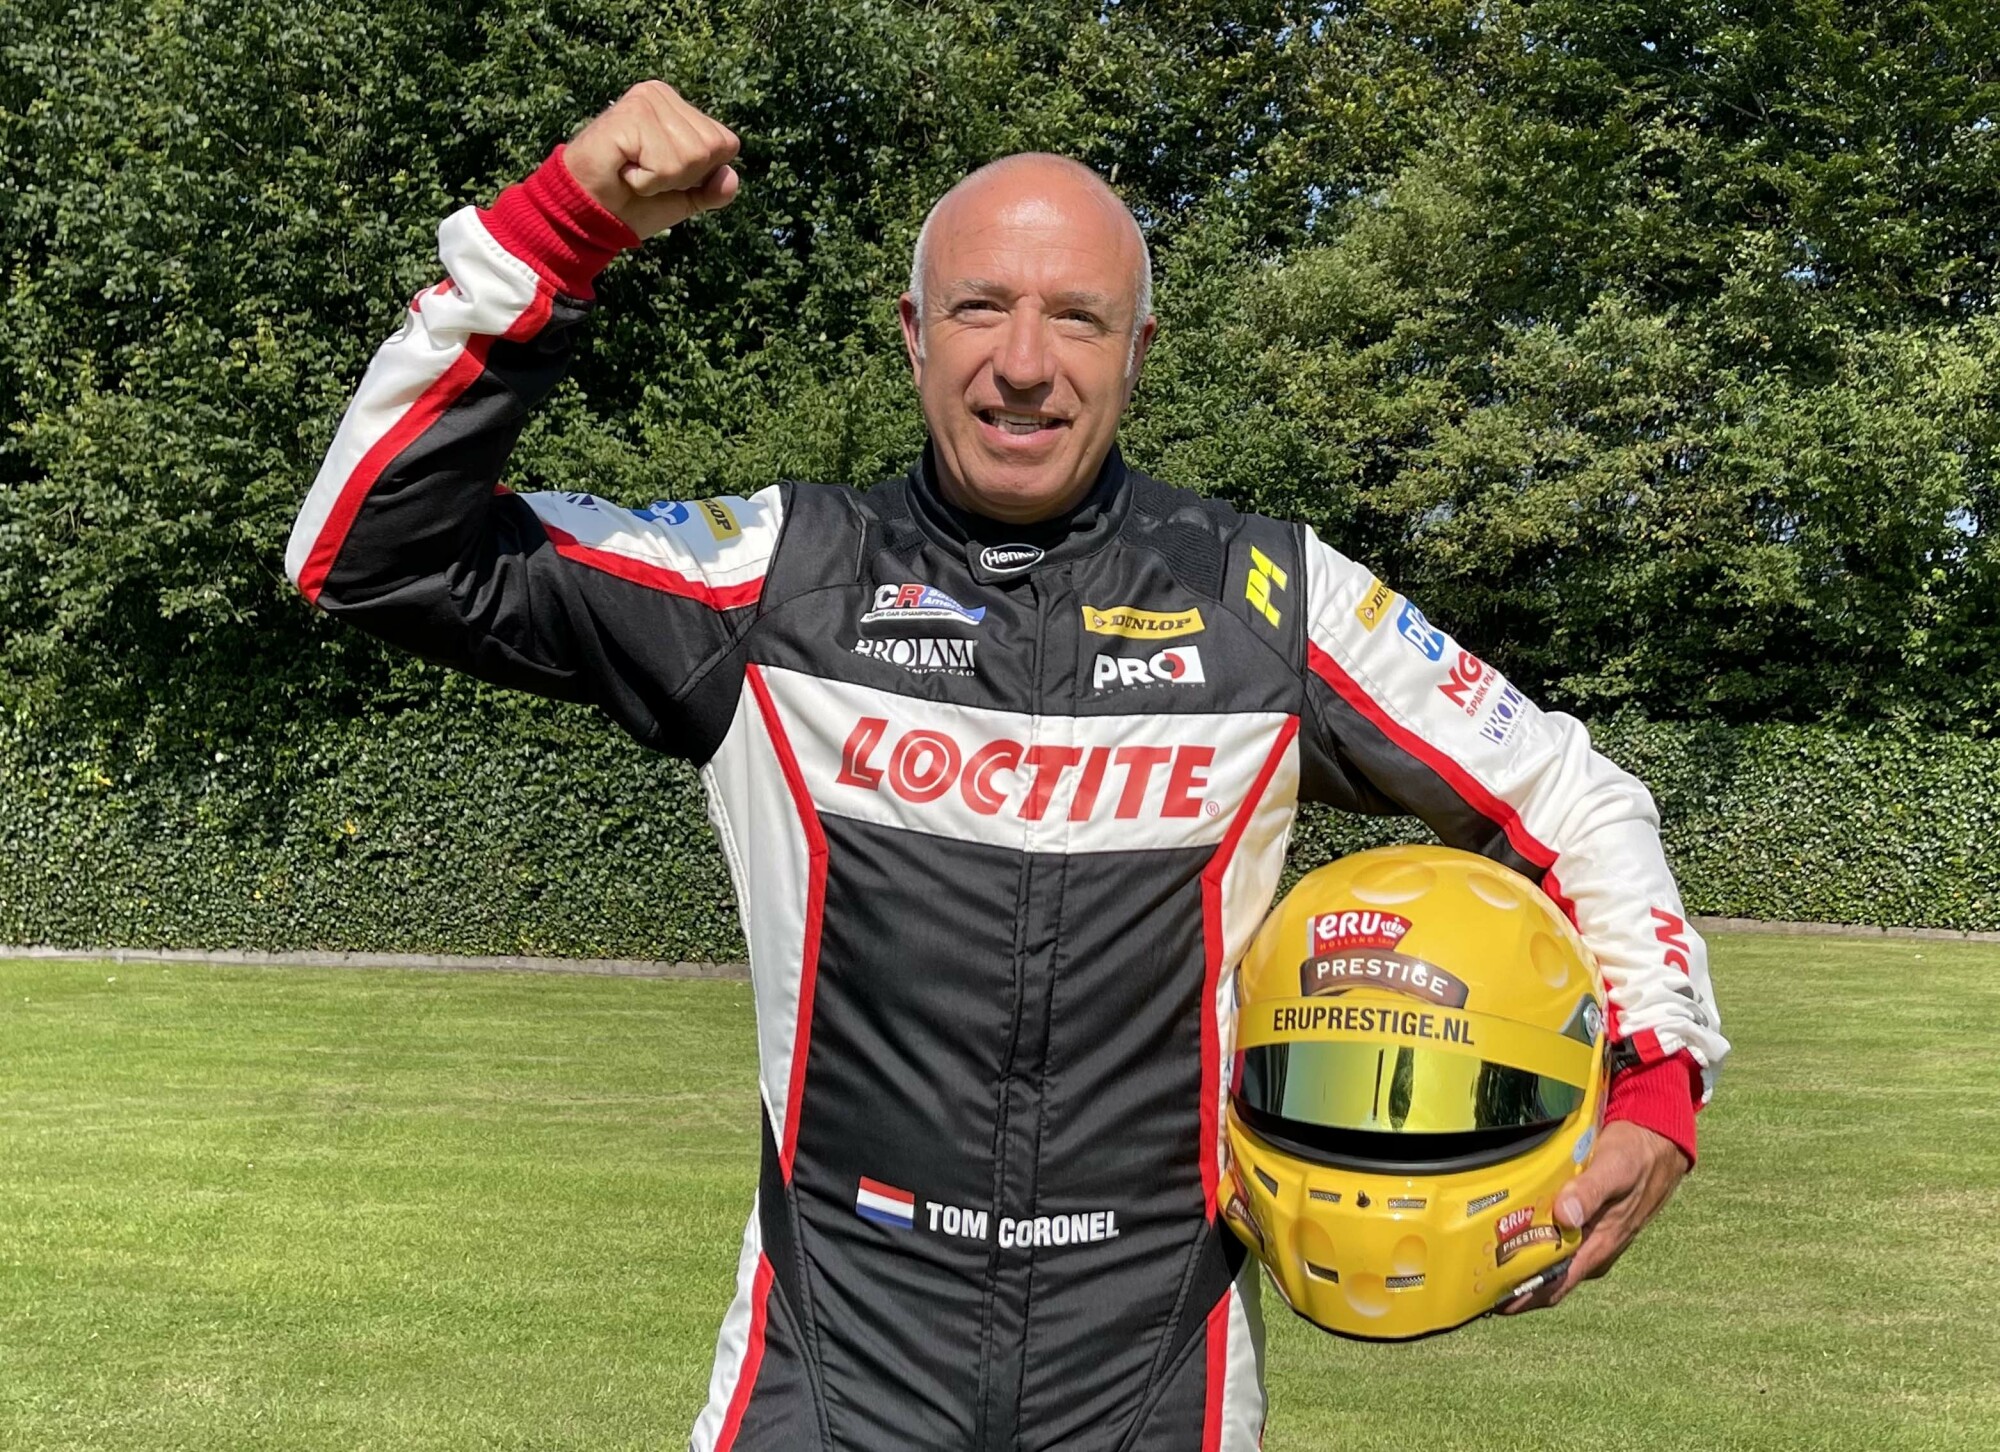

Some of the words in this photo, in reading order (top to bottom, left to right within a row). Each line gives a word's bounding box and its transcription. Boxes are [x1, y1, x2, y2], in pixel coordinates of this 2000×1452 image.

[885, 610, 900, 618] CAR
[1110, 614, 1191, 631] DUNLOP
[1437, 651, 1482, 709] NG
[1466, 684, 1489, 717] SPARK
[835, 716, 1216, 822] LOCTITE
[1320, 936, 1375, 951] HOLLAND
[1316, 958, 1450, 997] PRESTIGE
[1273, 1007, 1475, 1046] ERUPRESTIGE.NL
[926, 1201, 988, 1240] TOM
[999, 1210, 1120, 1249] CORONEL
[1503, 1226, 1553, 1253] PRESTIGE
